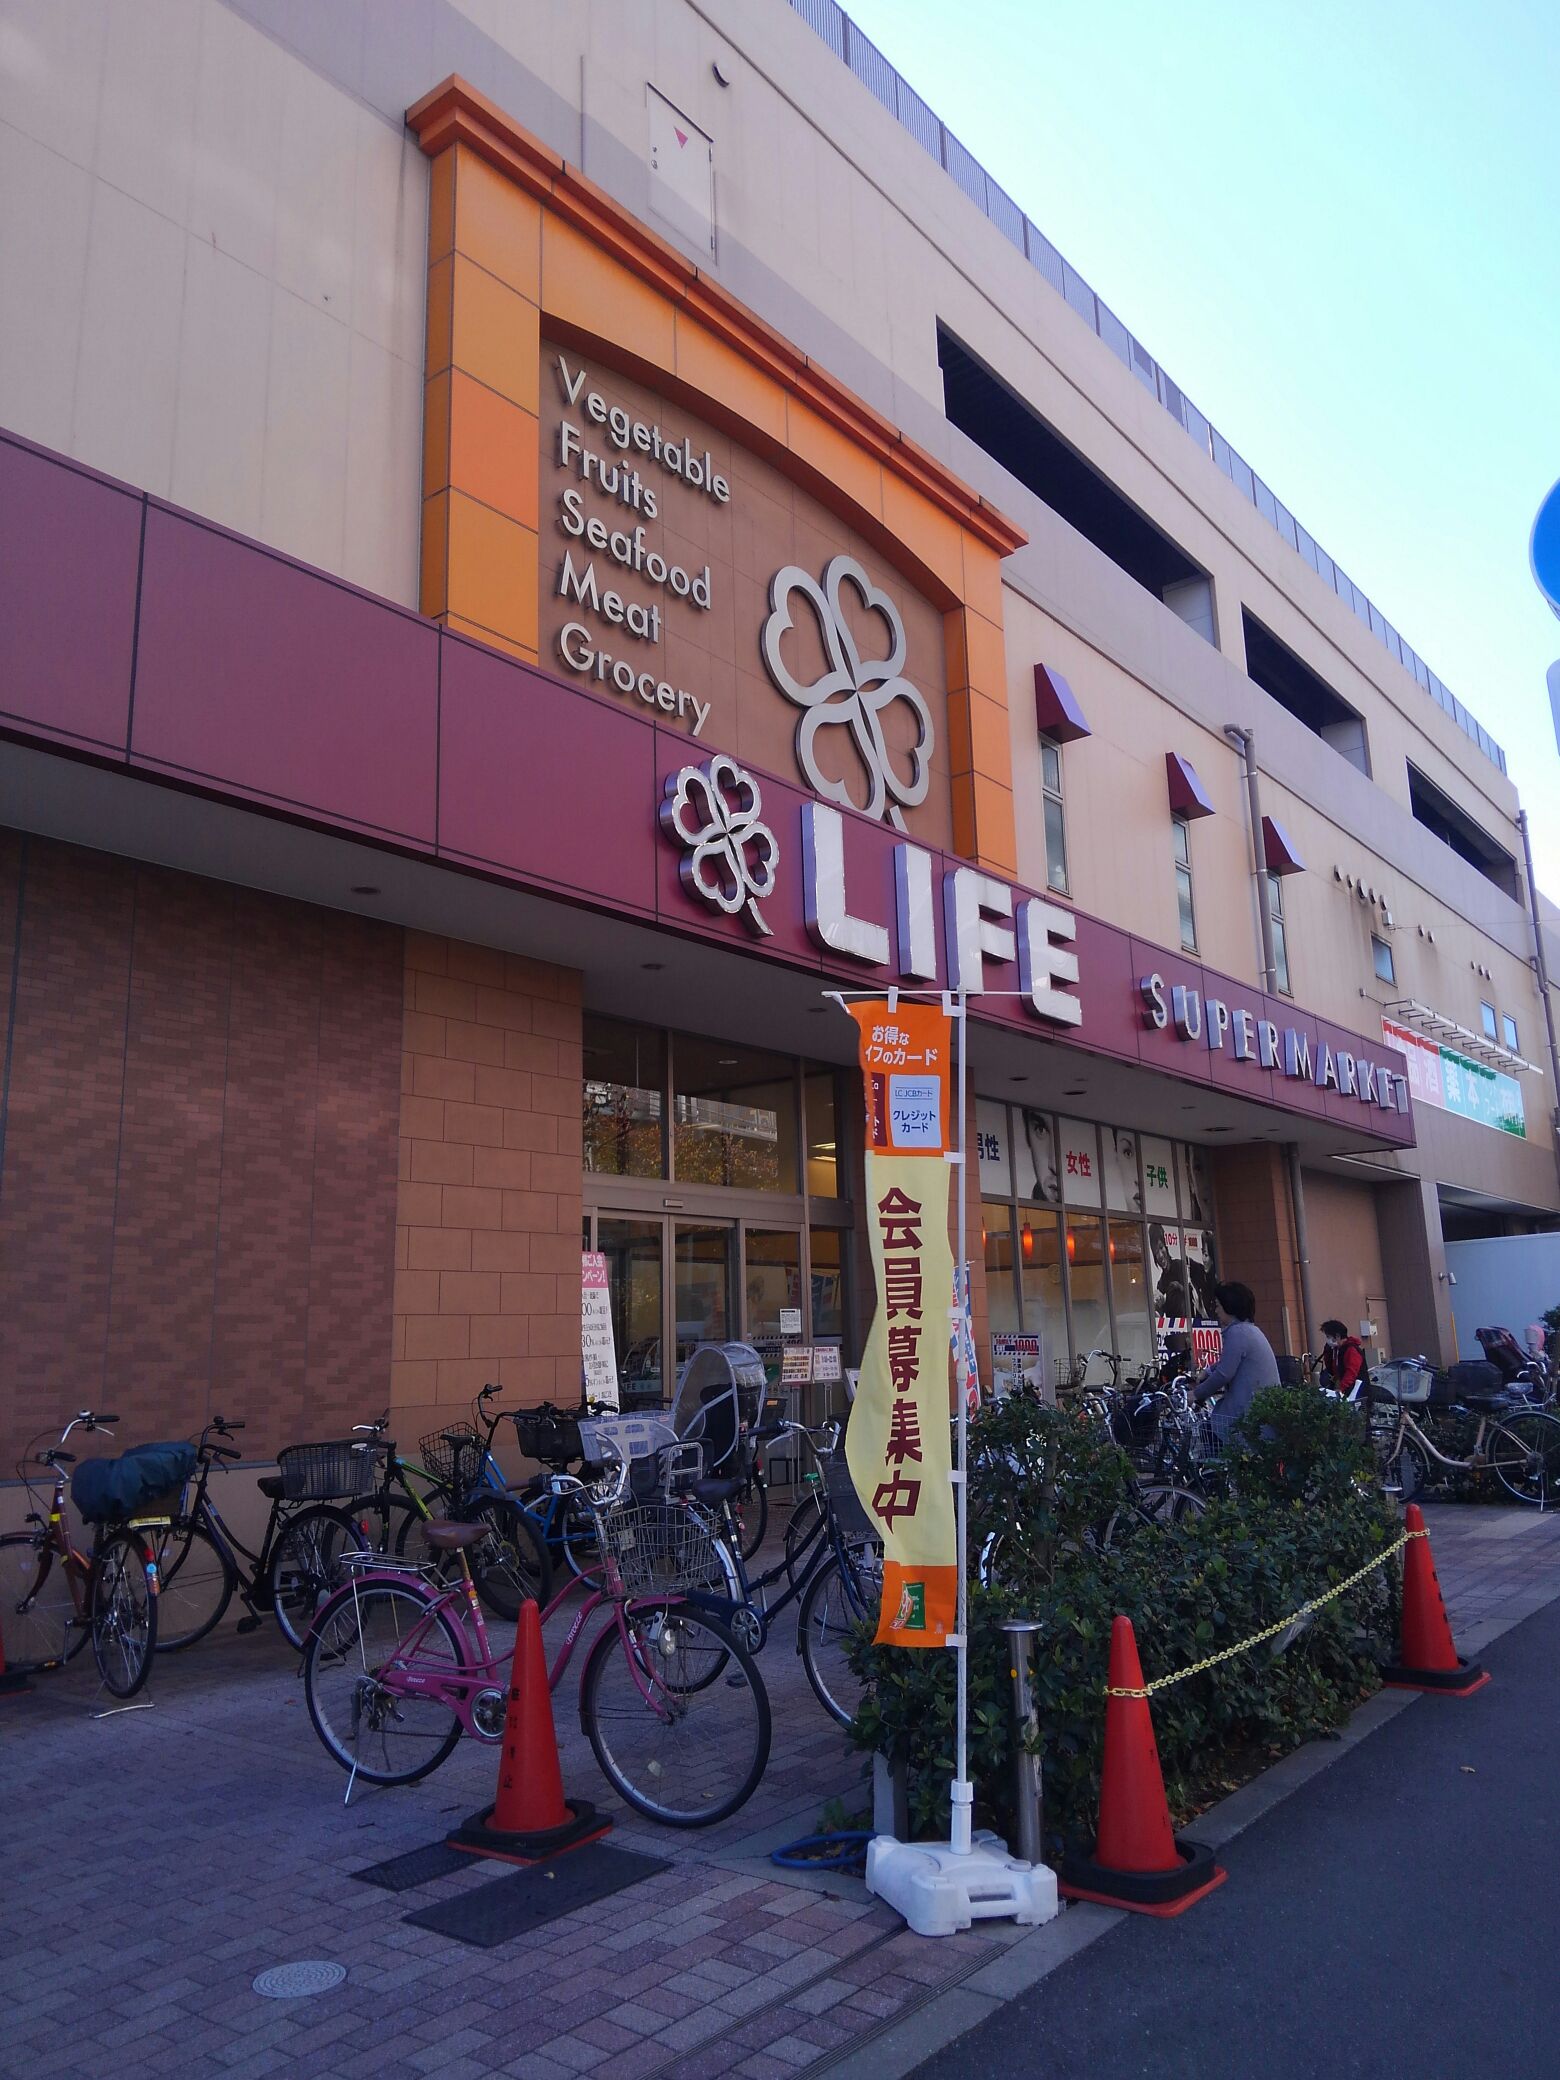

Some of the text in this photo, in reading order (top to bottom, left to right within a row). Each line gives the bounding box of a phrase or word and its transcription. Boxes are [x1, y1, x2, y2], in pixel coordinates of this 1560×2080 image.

[557, 354, 731, 503] Vegetable
[558, 420, 659, 519] Fruits
[558, 550, 661, 643] Meat
[560, 488, 711, 611] Seafood
[558, 622, 712, 737] Grocery
[801, 801, 1083, 1028] LIFE
[871, 1025, 910, 1046] お得な
[1140, 973, 1409, 1115] SUPERMARKET
[893, 1110, 936, 1122] クレジット
[901, 1122, 929, 1133] カード
[1065, 1151, 1092, 1178] 女性
[1146, 1164, 1169, 1190] 子供
[871, 1187, 923, 1536] 会員募集中
